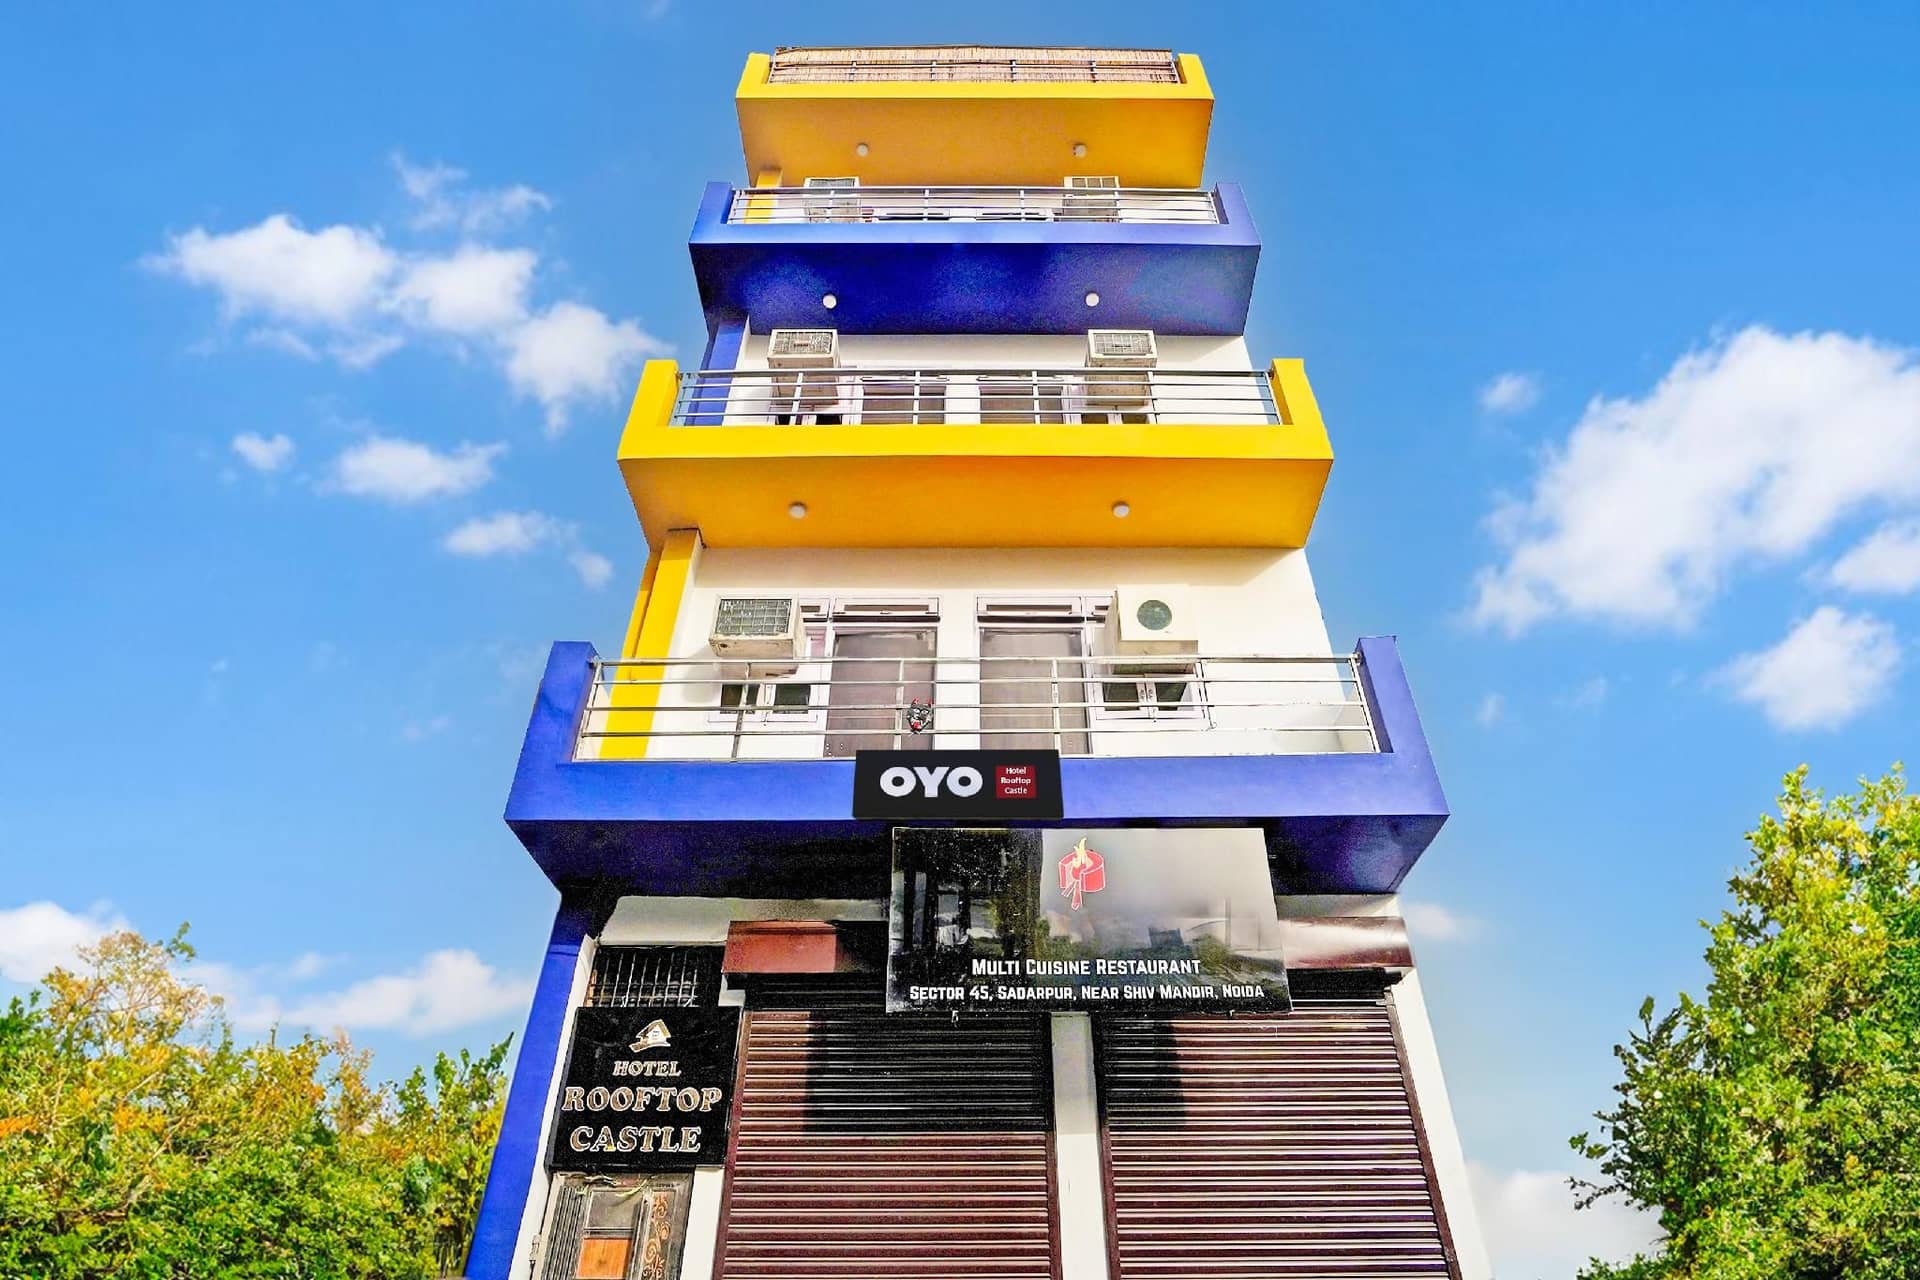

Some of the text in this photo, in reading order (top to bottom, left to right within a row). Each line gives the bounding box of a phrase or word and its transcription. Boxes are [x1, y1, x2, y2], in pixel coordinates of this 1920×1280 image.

[1006, 766, 1027, 775] Hotel
[879, 766, 983, 797] OYO
[1000, 776, 1031, 786] Rooftop
[1004, 786, 1028, 794] Castle
[969, 985, 993, 1001] 45,
[612, 1060, 682, 1077] HOTEL
[562, 1086, 722, 1112] ROOFTOP
[569, 1125, 702, 1152] CASTLE
